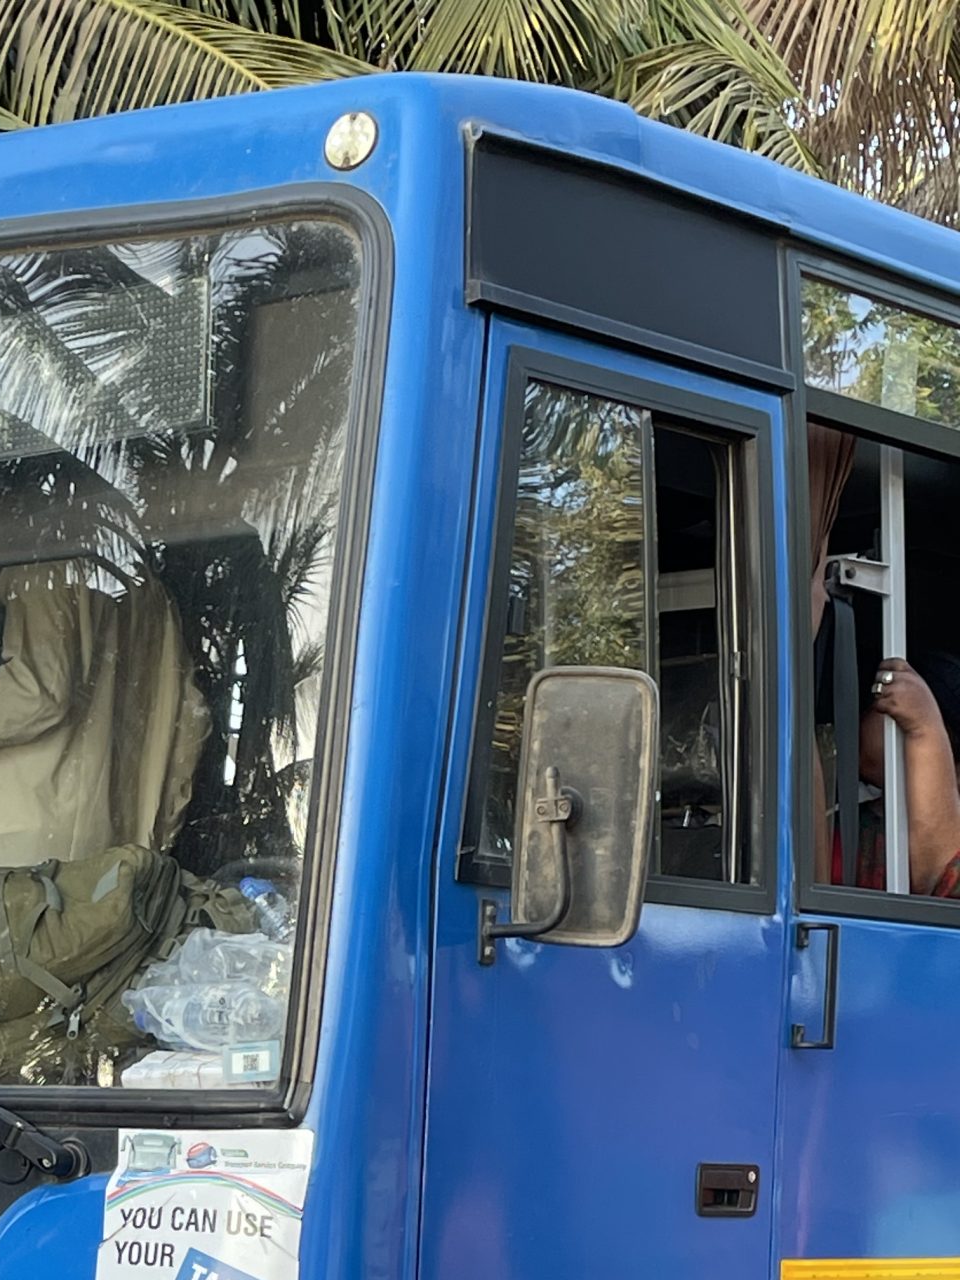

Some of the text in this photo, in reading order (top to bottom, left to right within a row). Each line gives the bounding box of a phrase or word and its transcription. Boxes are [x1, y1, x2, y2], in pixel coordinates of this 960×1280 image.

[120, 1206, 274, 1238] YOU CAN USE
[115, 1240, 175, 1267] YOUR
